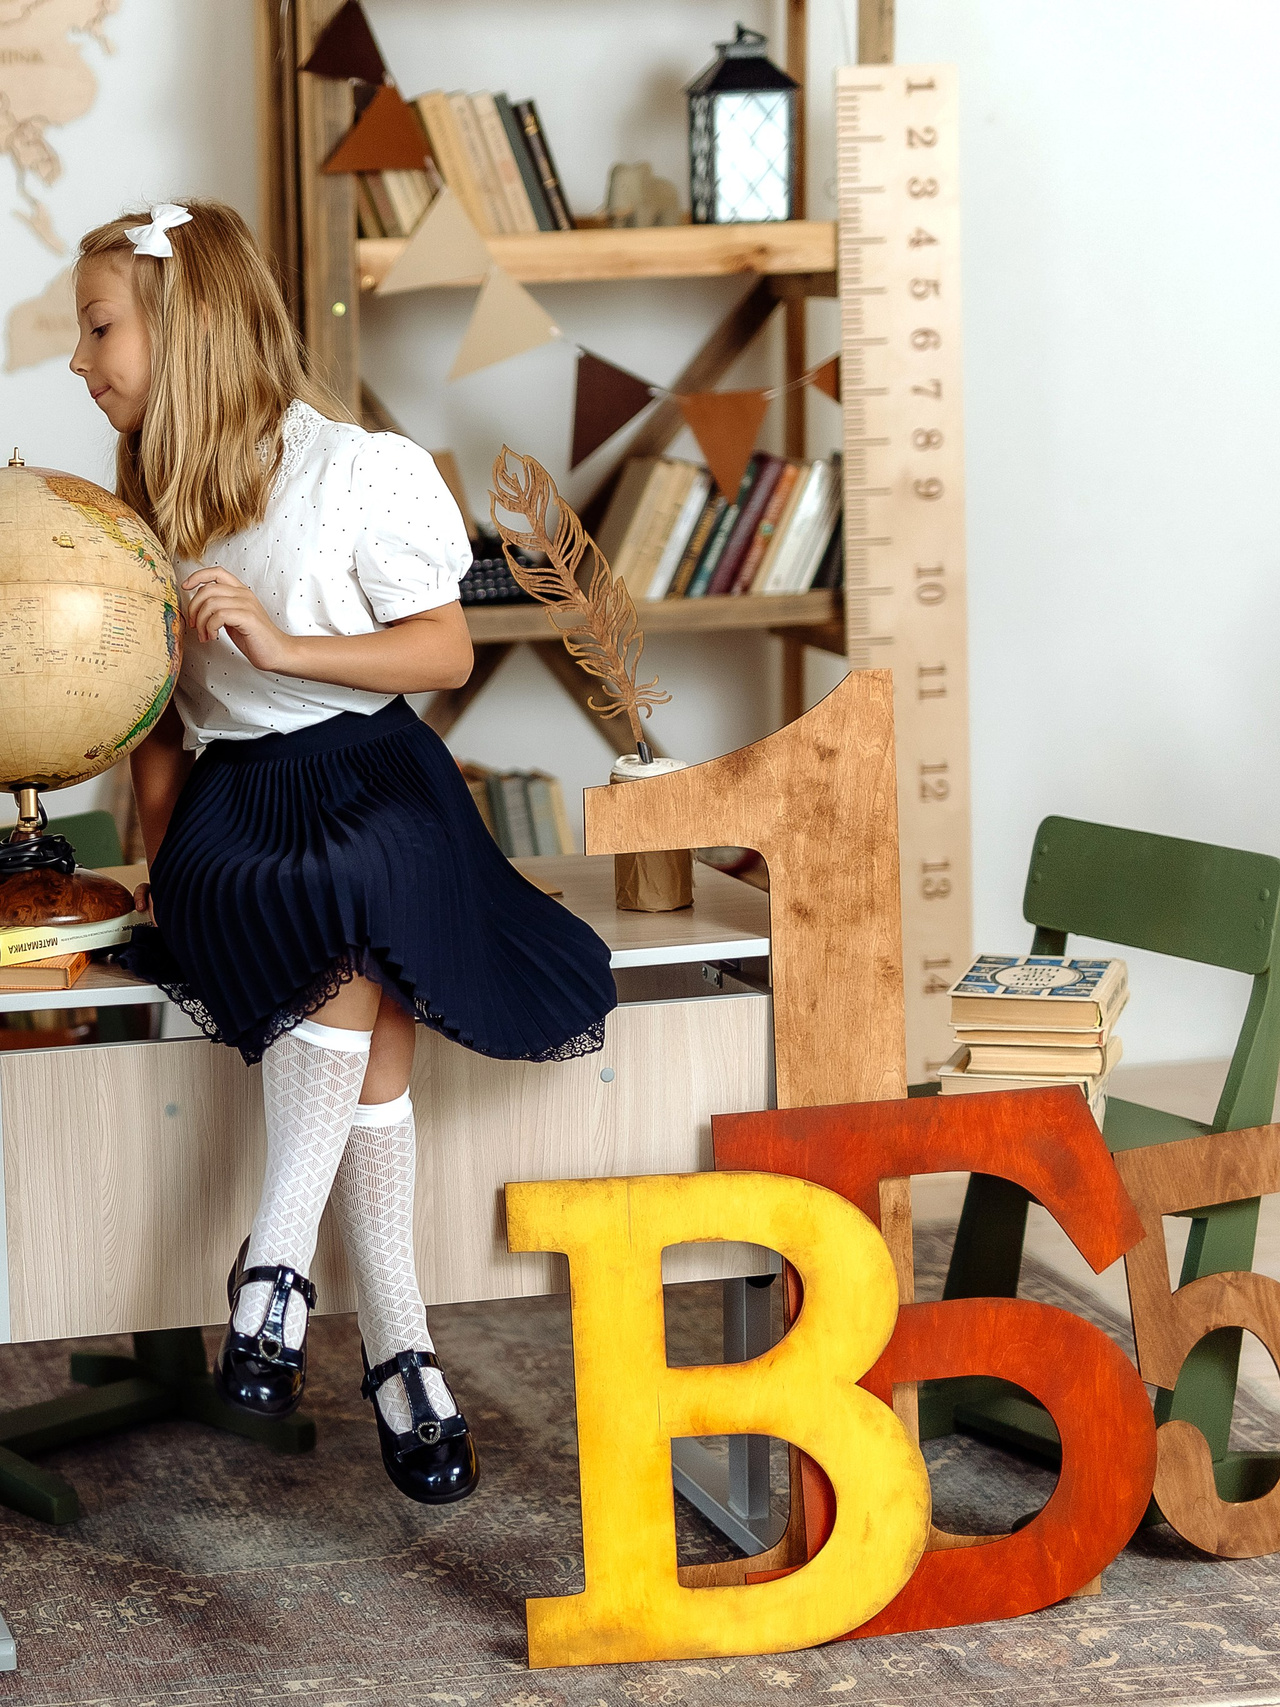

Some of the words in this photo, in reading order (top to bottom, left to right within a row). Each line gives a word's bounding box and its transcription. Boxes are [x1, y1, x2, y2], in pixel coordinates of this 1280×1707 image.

[905, 77, 936, 97] 1
[906, 126, 938, 149] 2
[907, 176, 939, 200] 3
[908, 227, 940, 249] 4
[909, 277, 940, 301] 5
[910, 327, 941, 352] 6
[911, 378, 942, 400] 7
[912, 427, 944, 452] 8
[913, 477, 945, 501] 9
[916, 562, 945, 608] 10
[918, 662, 948, 701] 11
[920, 761, 950, 802] 12
[922, 858, 952, 901] 13
[7, 936, 59, 955] МАТЕМАТИКА
[923, 955, 952, 995] 14
